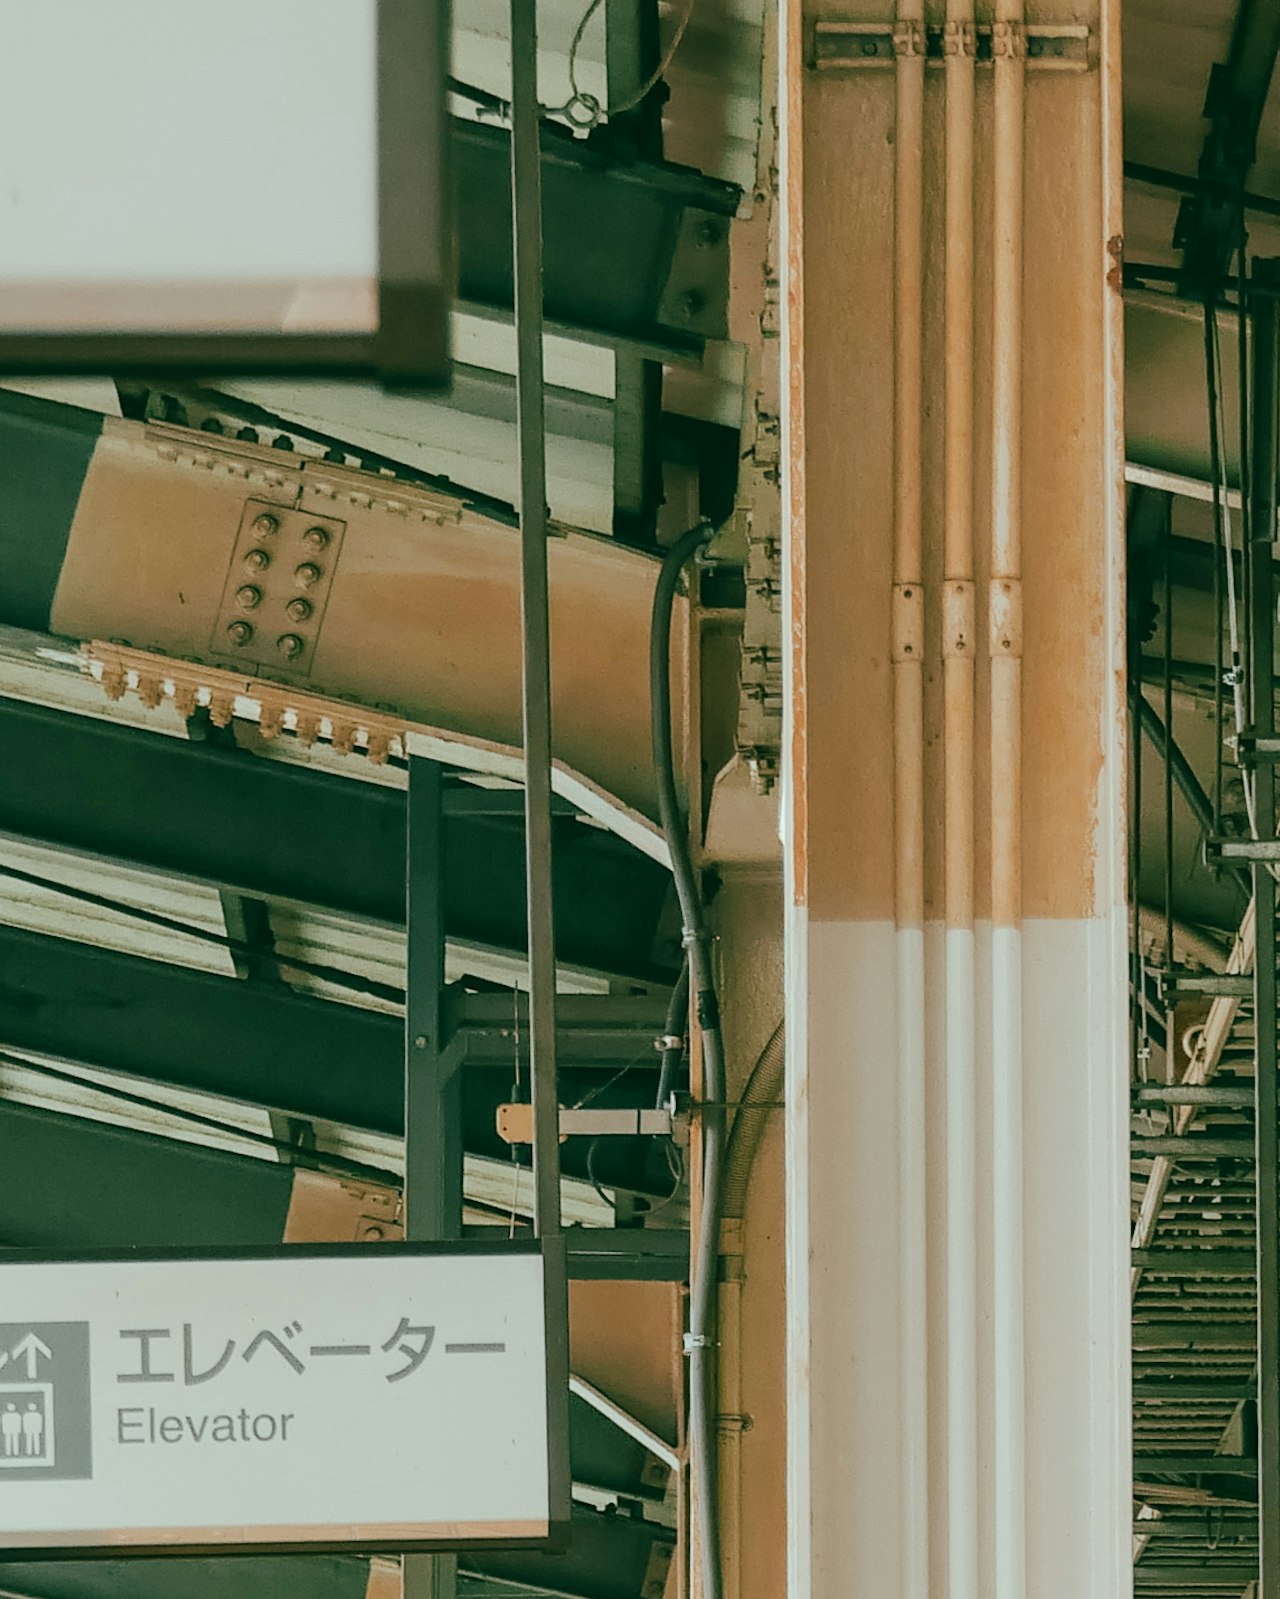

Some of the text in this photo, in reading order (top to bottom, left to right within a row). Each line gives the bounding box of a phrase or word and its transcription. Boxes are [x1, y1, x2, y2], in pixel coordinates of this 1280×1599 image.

[116, 1316, 506, 1386] エレベーター
[116, 1407, 295, 1445] Elevator
